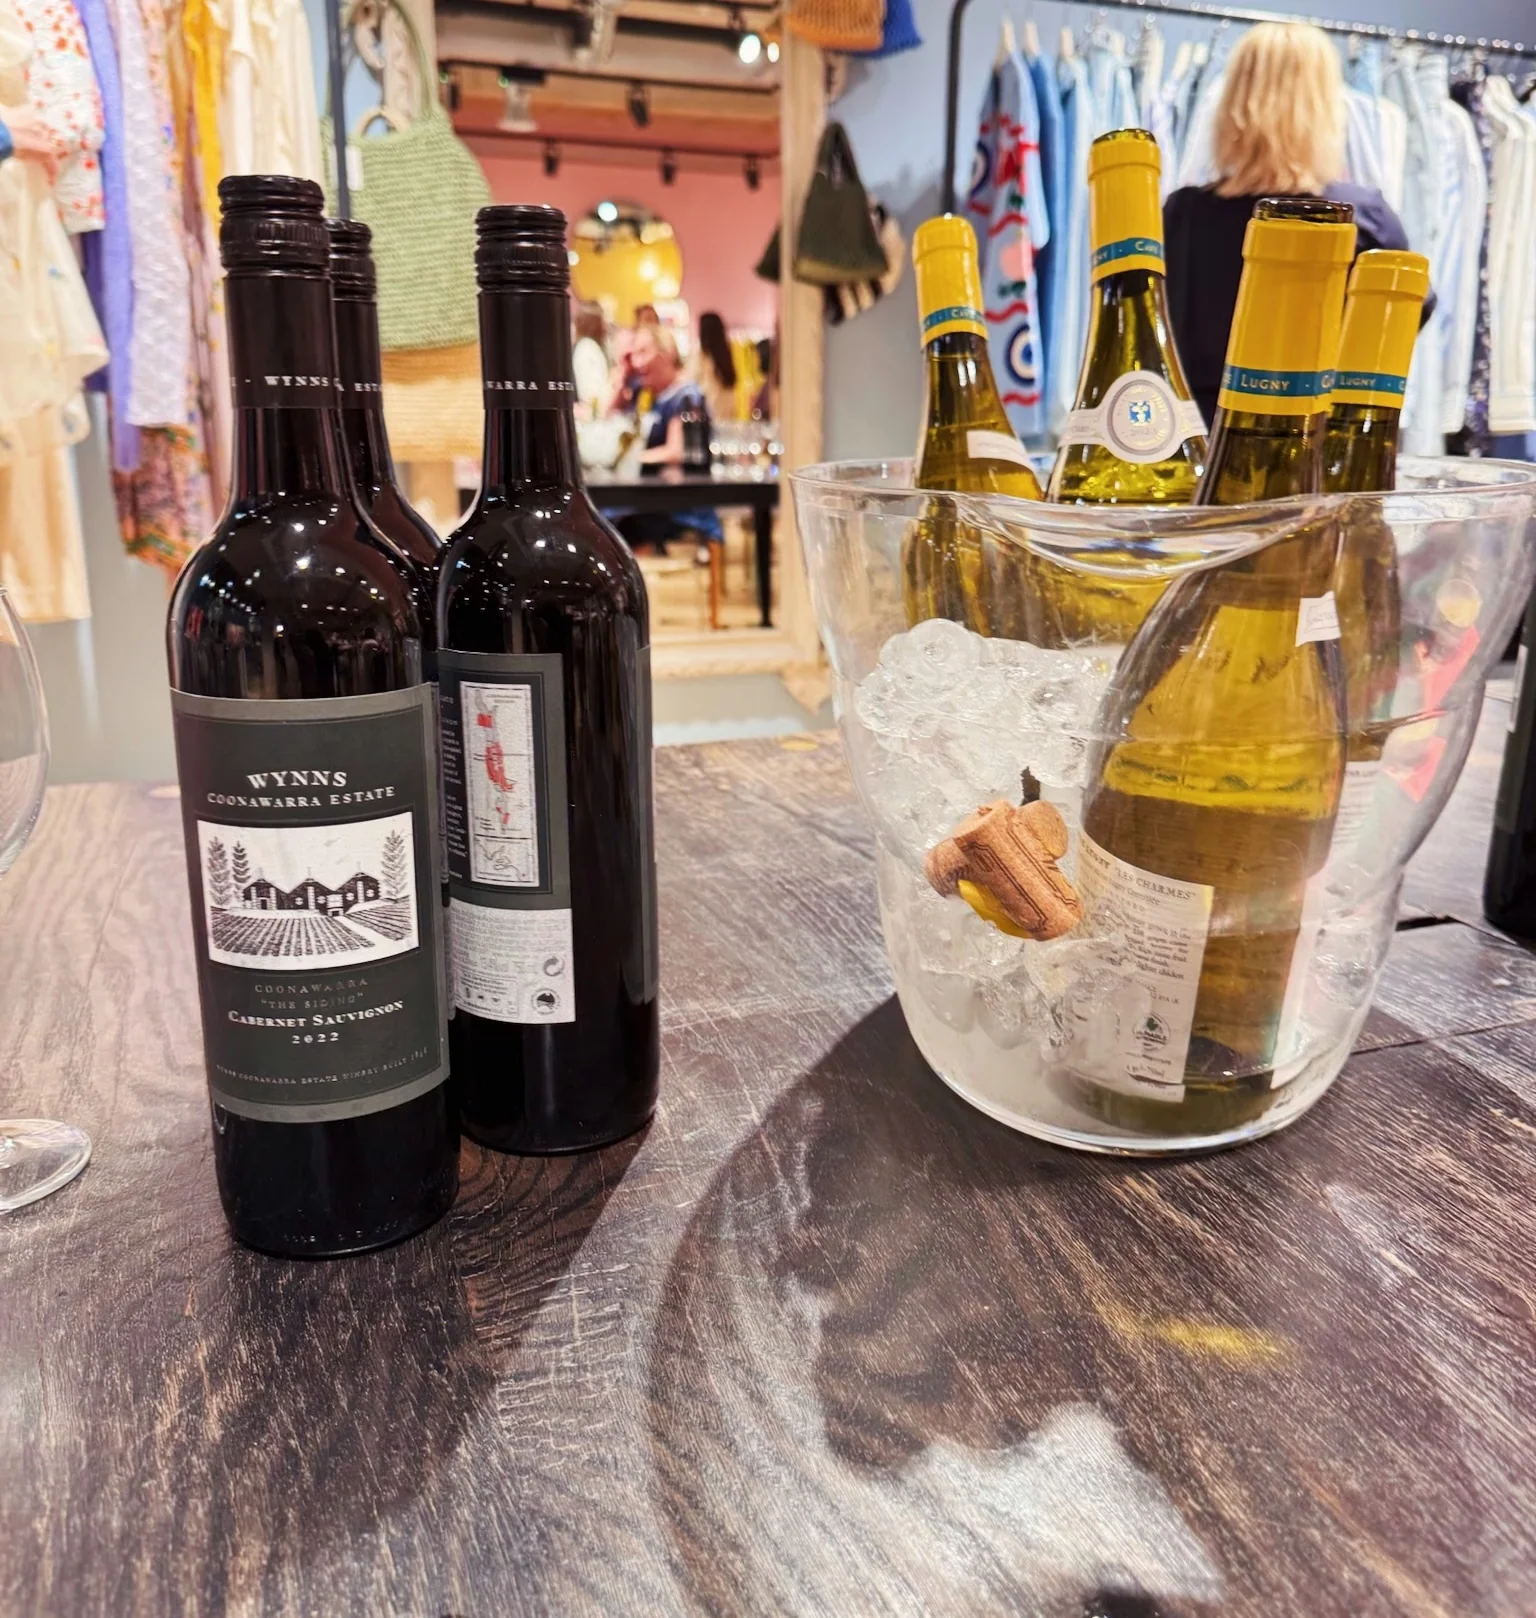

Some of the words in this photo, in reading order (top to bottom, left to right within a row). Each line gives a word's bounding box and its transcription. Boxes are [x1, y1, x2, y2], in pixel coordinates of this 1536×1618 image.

[263, 375, 329, 387] WYNNS
[1240, 373, 1290, 391] LUGNY
[246, 769, 348, 791] WYNNS
[206, 791, 321, 809] COONAWARRA
[329, 786, 396, 806] ESTATE
[253, 977, 369, 995] COONAWARRA
[291, 1031, 340, 1045] 2022
